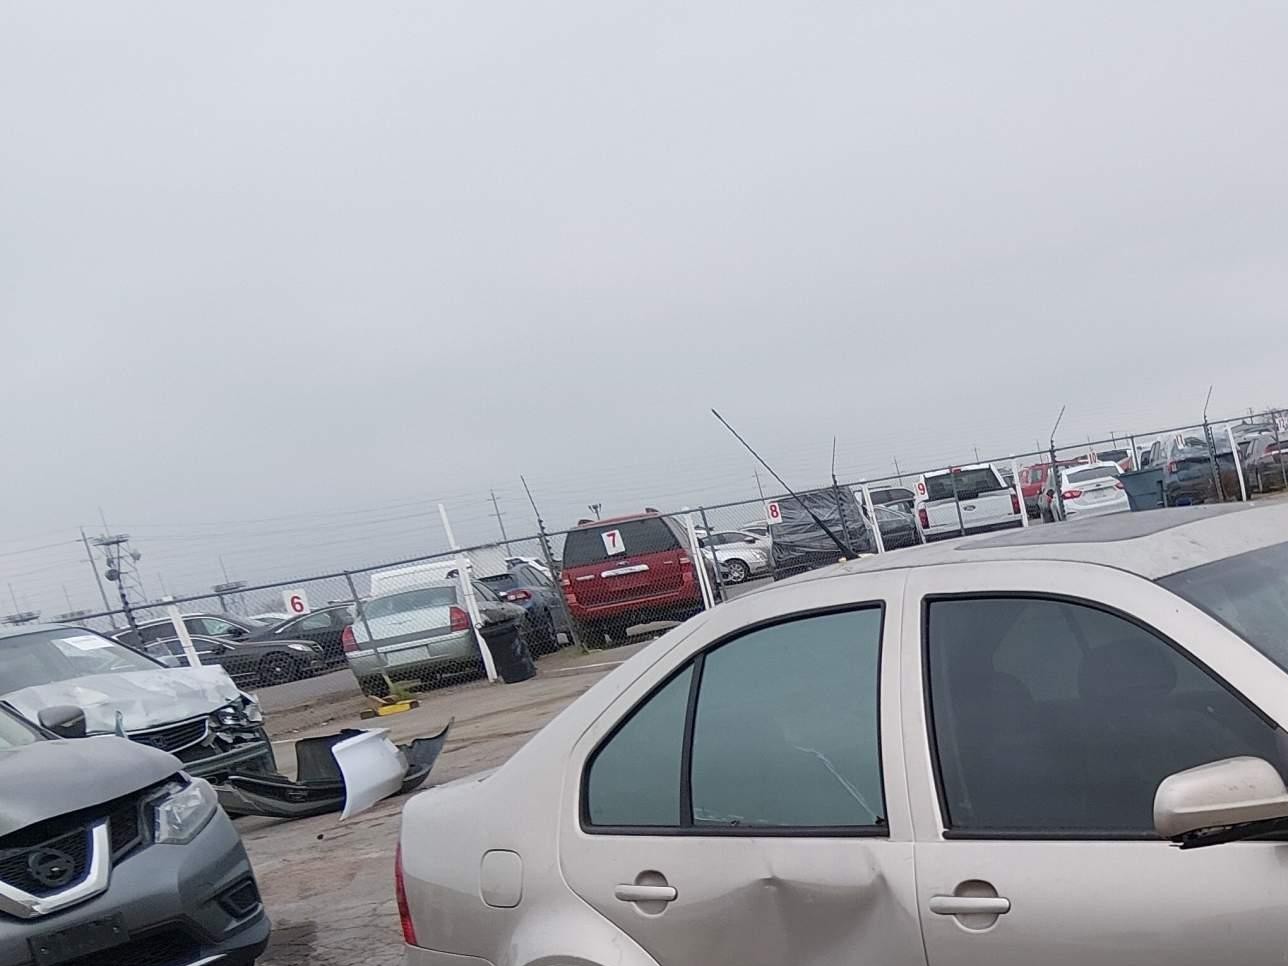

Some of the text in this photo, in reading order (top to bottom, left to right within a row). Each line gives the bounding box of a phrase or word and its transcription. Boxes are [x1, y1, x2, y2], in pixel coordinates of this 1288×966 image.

[917, 483, 925, 495] 9
[770, 504, 779, 518] 8
[606, 532, 616, 548] 7
[290, 595, 304, 612] 6
